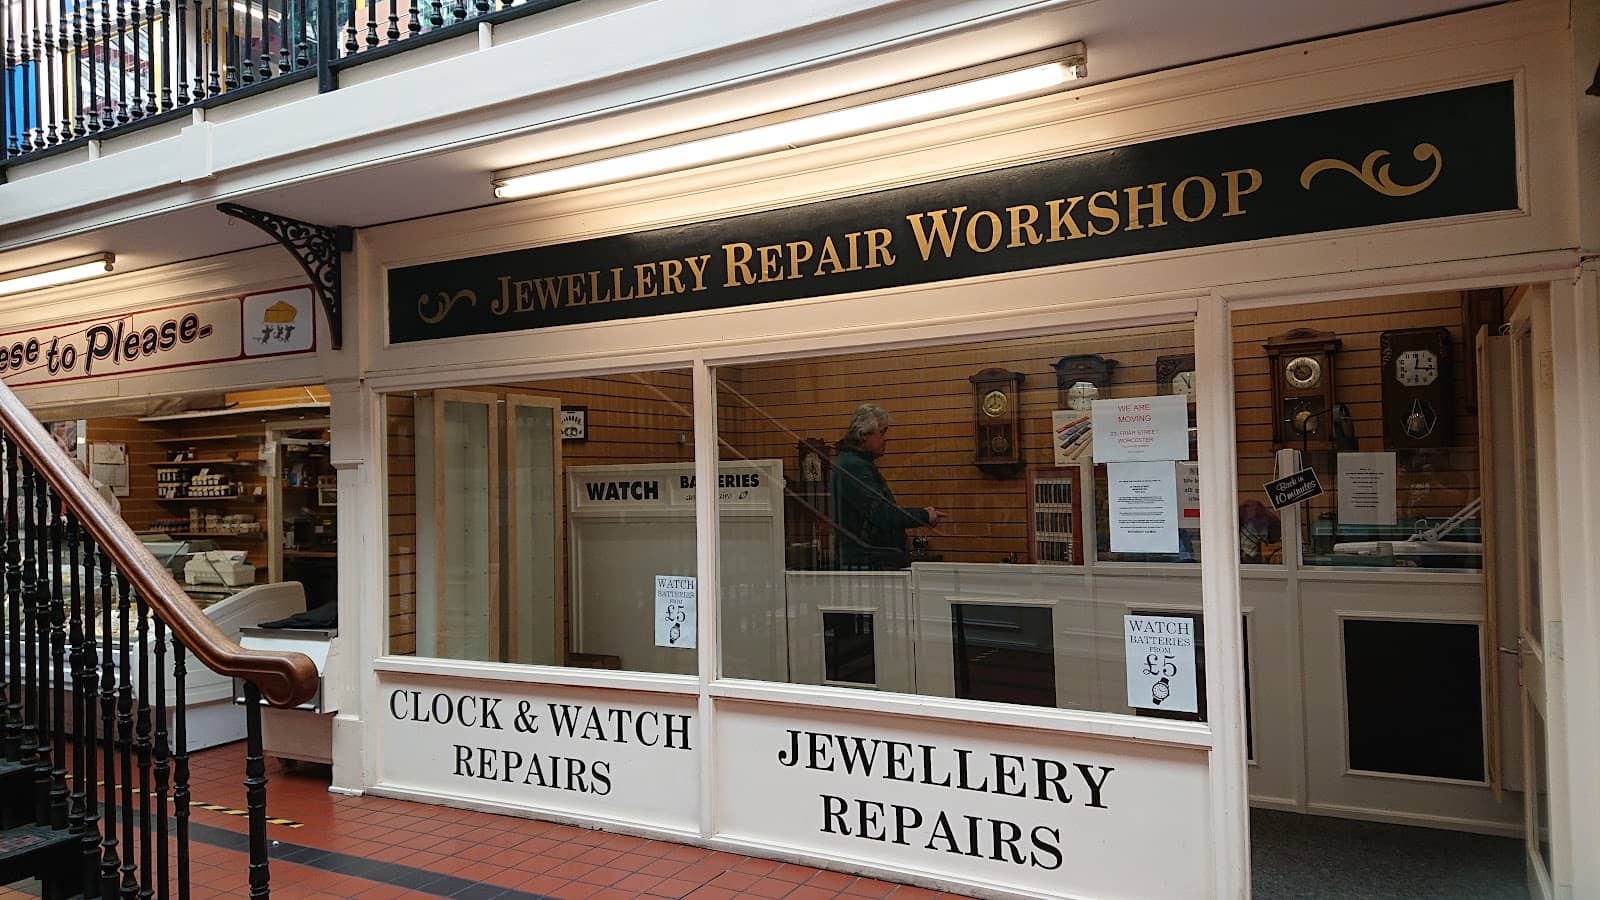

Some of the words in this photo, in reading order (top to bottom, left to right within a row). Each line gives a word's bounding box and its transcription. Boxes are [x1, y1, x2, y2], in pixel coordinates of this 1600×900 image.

[491, 255, 711, 316] JEWELLERY
[722, 228, 897, 288] REPAIR
[906, 168, 1264, 262] WORKSHOP
[47, 336, 77, 375] to
[1117, 414, 1152, 423] MOVING
[1118, 404, 1132, 412] WE
[1133, 403, 1151, 411] ARE
[586, 481, 659, 501] WATCH
[680, 474, 760, 489] BAERIES
[1275, 492, 1287, 505] 10
[1287, 480, 1317, 500] minutes
[657, 579, 694, 590] WATCH
[657, 590, 695, 598] BATTERIES
[665, 604, 686, 622] £5
[1129, 620, 1191, 635] WATCH
[1130, 635, 1191, 647] BATTERIES
[1149, 646, 1171, 654] FROM
[1143, 653, 1177, 677] £5
[390, 689, 503, 730] CLOCK
[513, 700, 539, 734] &
[547, 703, 693, 750] WATCH
[453, 744, 612, 796] REPAIRS
[778, 730, 1115, 809] JEWELLERY
[820, 794, 1063, 871] REPAIRS
